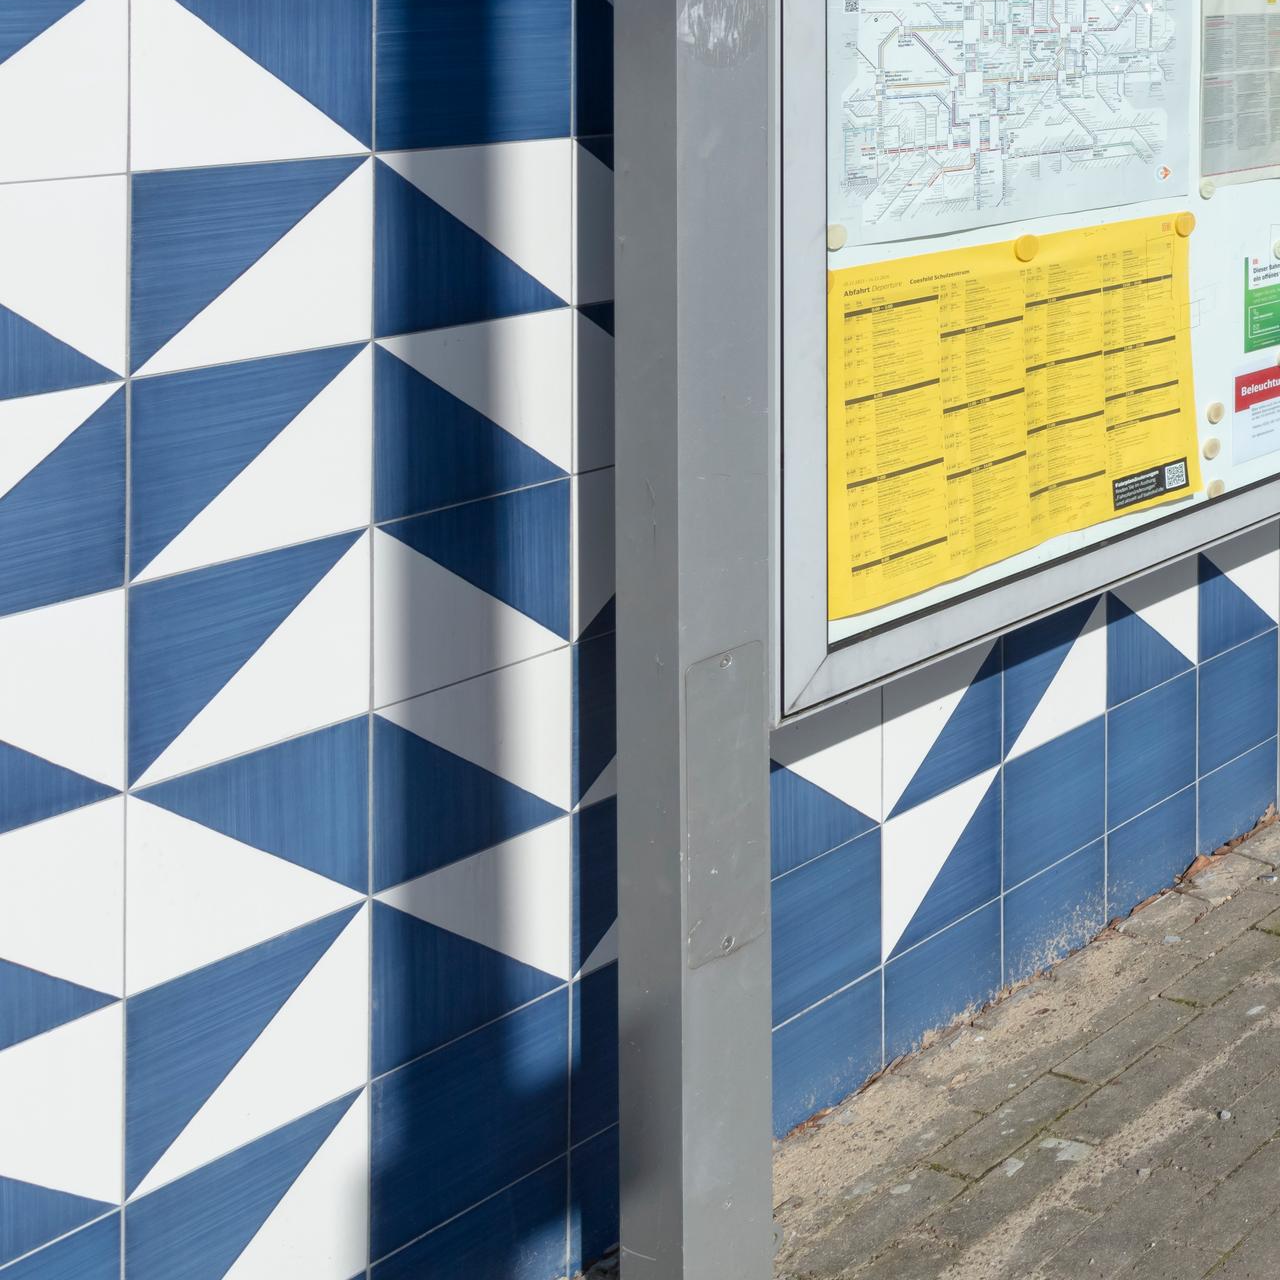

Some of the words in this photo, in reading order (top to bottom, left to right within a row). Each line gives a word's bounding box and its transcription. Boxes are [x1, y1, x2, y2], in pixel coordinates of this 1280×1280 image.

[1253, 265, 1268, 274] Dieser
[909, 275, 934, 285] Coesfeld
[934, 269, 970, 281] Schulzentrum
[1262, 272, 1279, 280] offenes
[844, 286, 870, 297] Abfahrt
[871, 281, 903, 292] Departure
